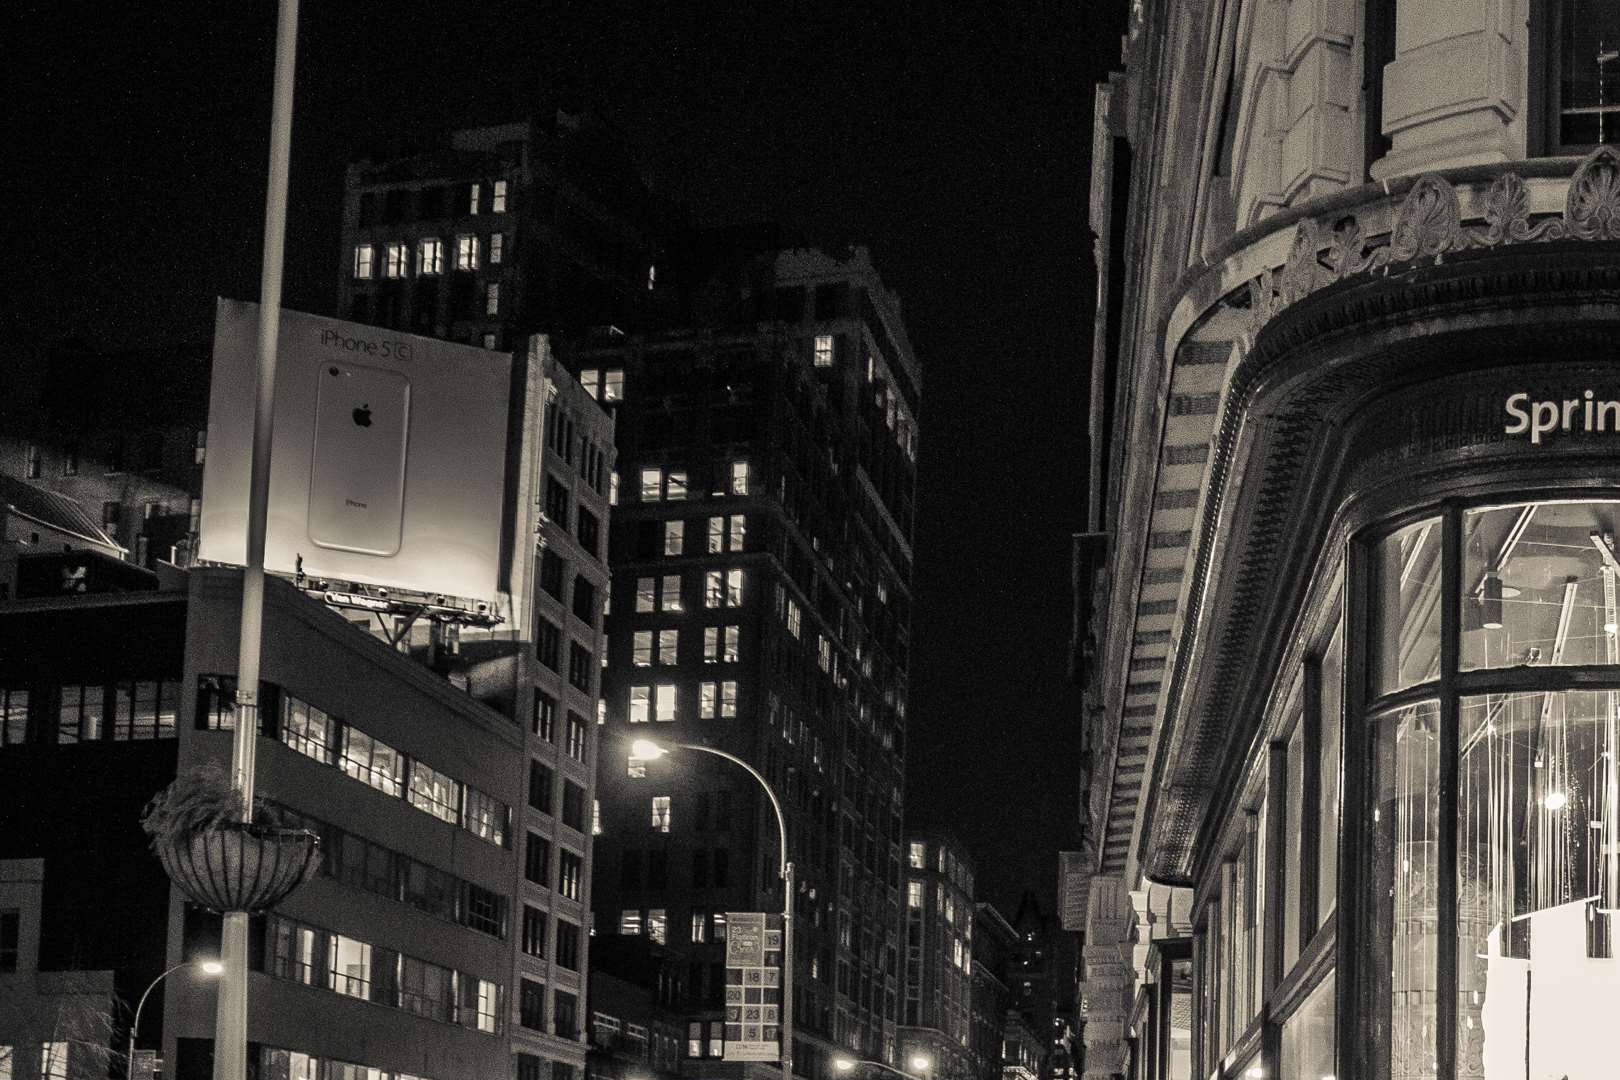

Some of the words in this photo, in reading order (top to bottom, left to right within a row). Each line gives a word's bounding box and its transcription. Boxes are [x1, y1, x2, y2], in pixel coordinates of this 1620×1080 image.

[320, 329, 378, 356] iPhone
[768, 935, 779, 946] 19
[748, 972, 760, 982] 18
[768, 972, 776, 982] 7
[746, 1009, 760, 1020] 23
